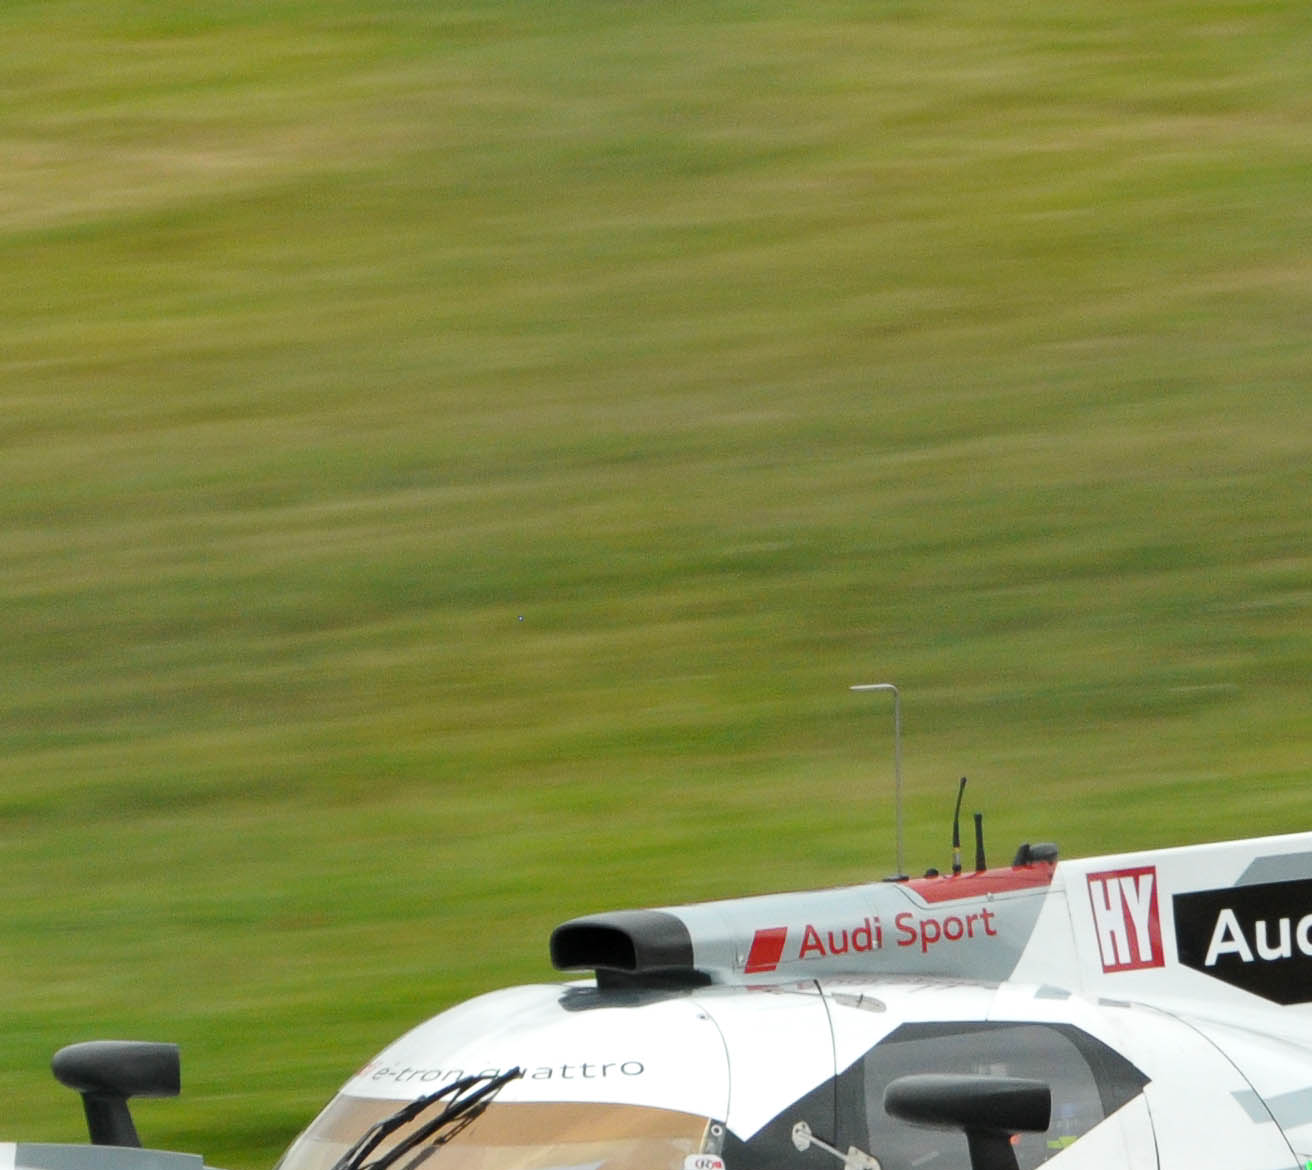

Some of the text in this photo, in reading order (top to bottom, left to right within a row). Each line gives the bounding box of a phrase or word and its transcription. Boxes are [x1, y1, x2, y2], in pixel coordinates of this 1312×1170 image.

[799, 908, 997, 960] Audi Sport
[1089, 873, 1155, 966] HY
[372, 1065, 464, 1083] e-tron
